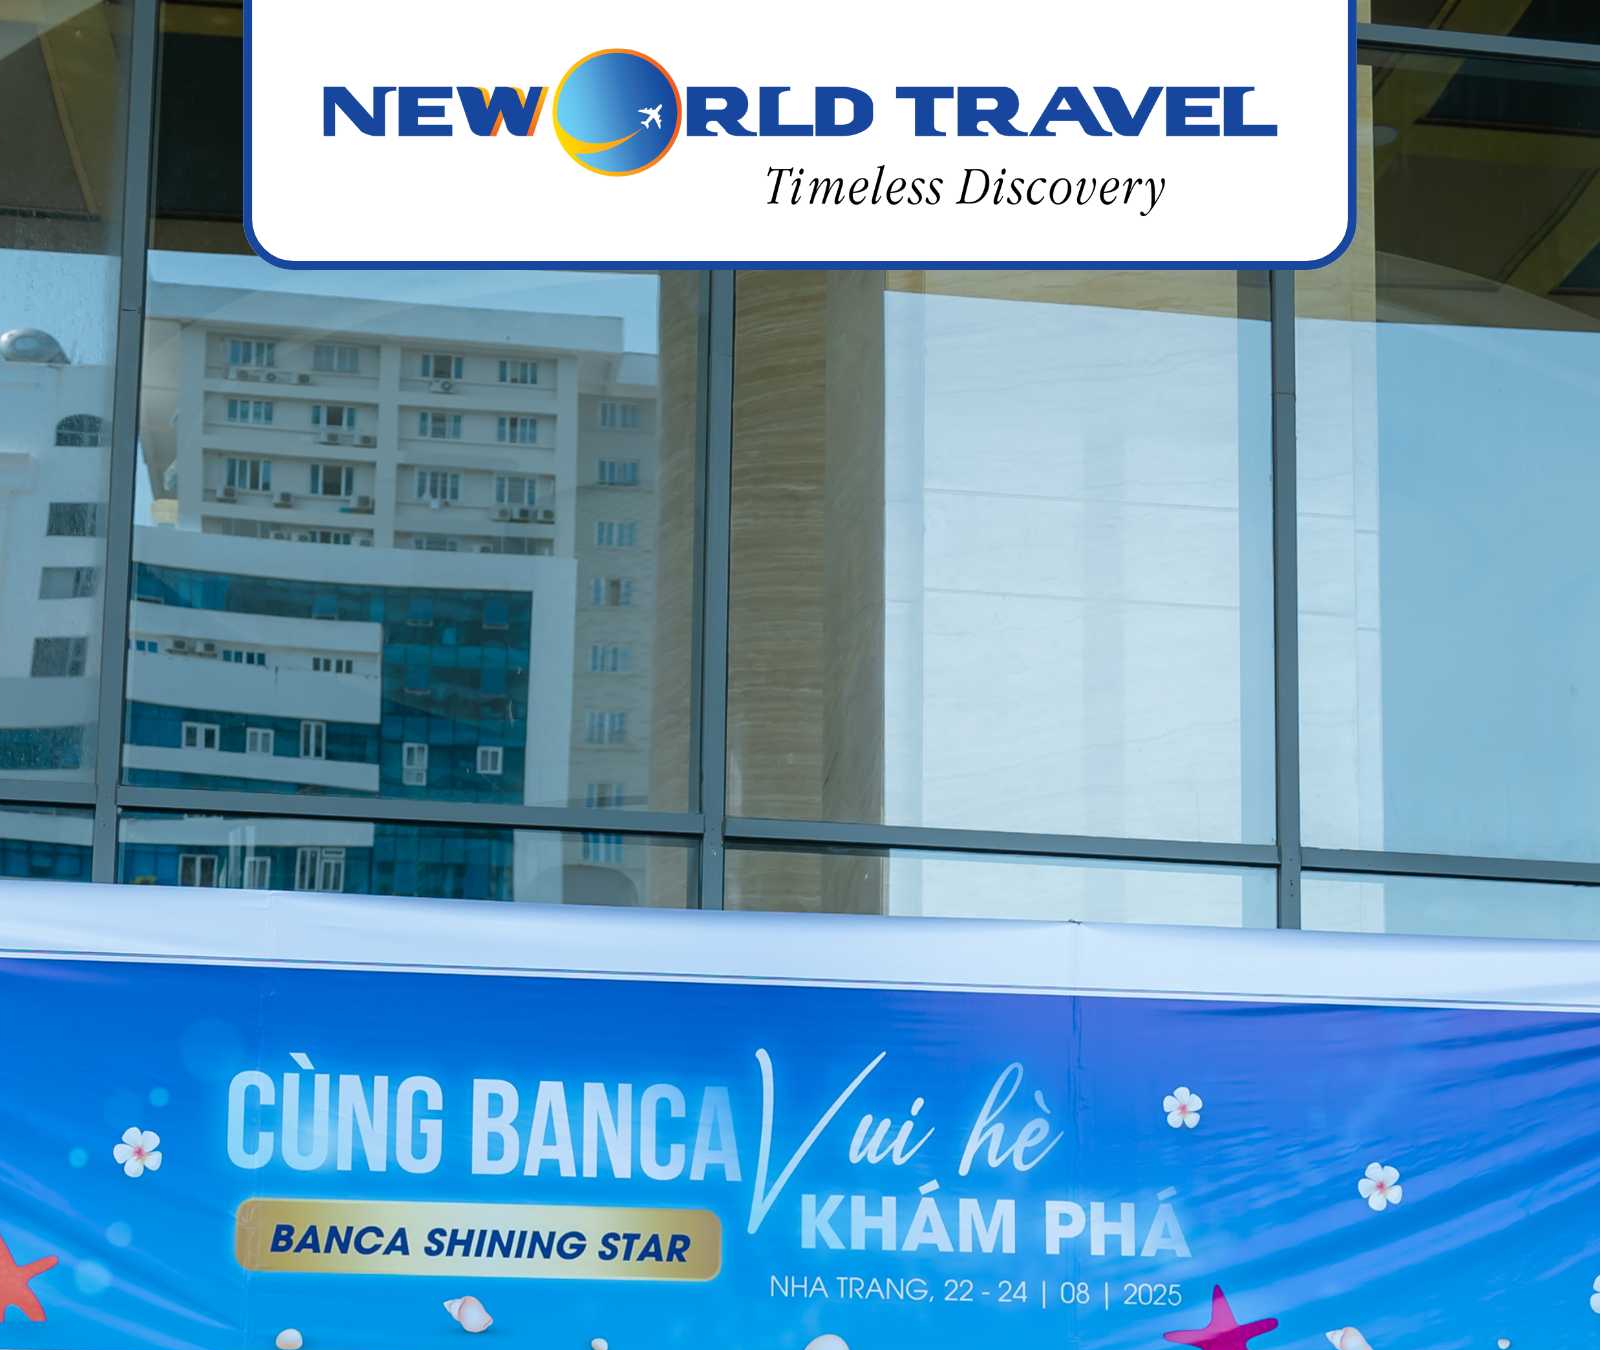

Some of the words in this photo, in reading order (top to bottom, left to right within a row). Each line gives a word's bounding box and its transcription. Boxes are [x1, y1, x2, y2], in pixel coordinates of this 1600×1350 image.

[227, 1052, 443, 1175] CÙNG
[471, 1078, 742, 1182] BANCA
[748, 1048, 935, 1235] Vui
[958, 1062, 1064, 1177] hè
[270, 1224, 410, 1256] BANCA
[423, 1228, 587, 1260] SHINING
[598, 1231, 692, 1263] STAR
[800, 1178, 1017, 1255] KHÁM
[1044, 1185, 1193, 1258] PHÁ
[770, 1275, 829, 1299] NHA
[836, 1276, 935, 1304] TRANG,
[943, 1279, 974, 1303] 22
[998, 1280, 1028, 1304] 24
[1060, 1282, 1090, 1305] 08
[1123, 1283, 1183, 1307] 2025
